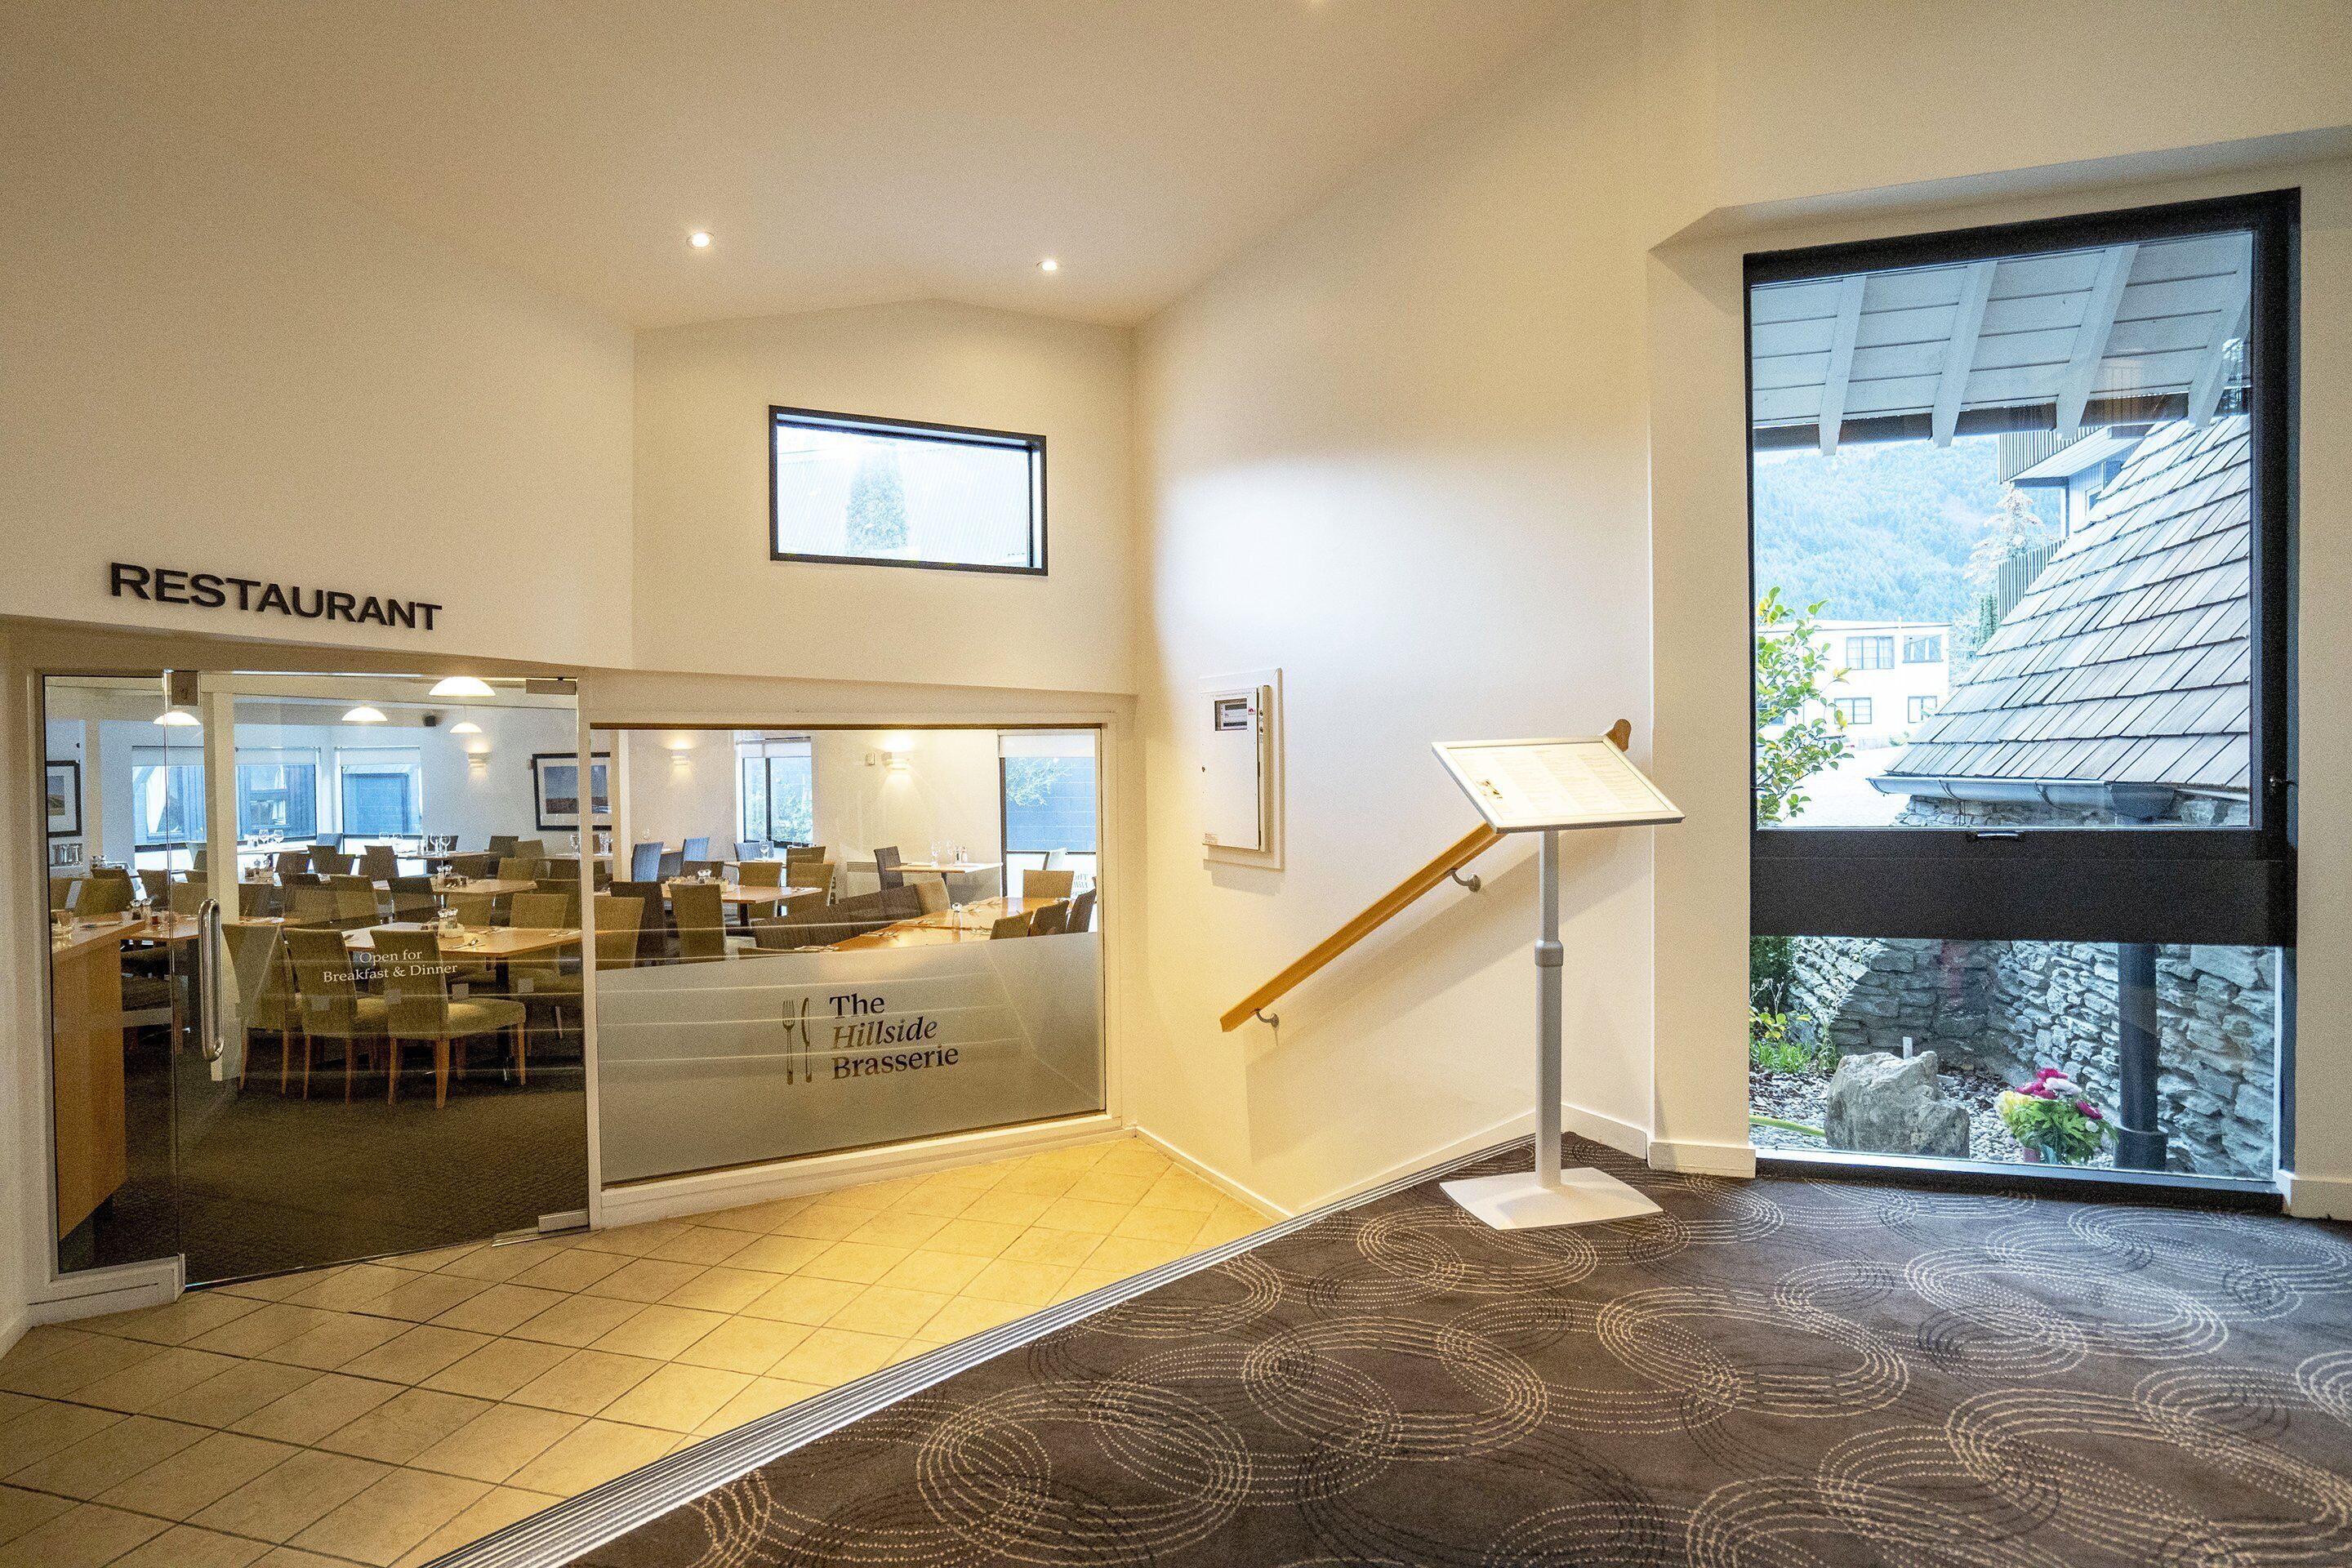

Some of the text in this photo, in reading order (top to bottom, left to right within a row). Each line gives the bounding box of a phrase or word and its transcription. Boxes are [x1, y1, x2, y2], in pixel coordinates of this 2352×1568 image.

[110, 562, 442, 630] RESTAURANT
[359, 949, 422, 965] Open for
[323, 964, 458, 982] Breakfast & Dinner
[829, 993, 885, 1019] The
[831, 1016, 938, 1049] Hillside
[831, 1044, 959, 1080] Brasserie
